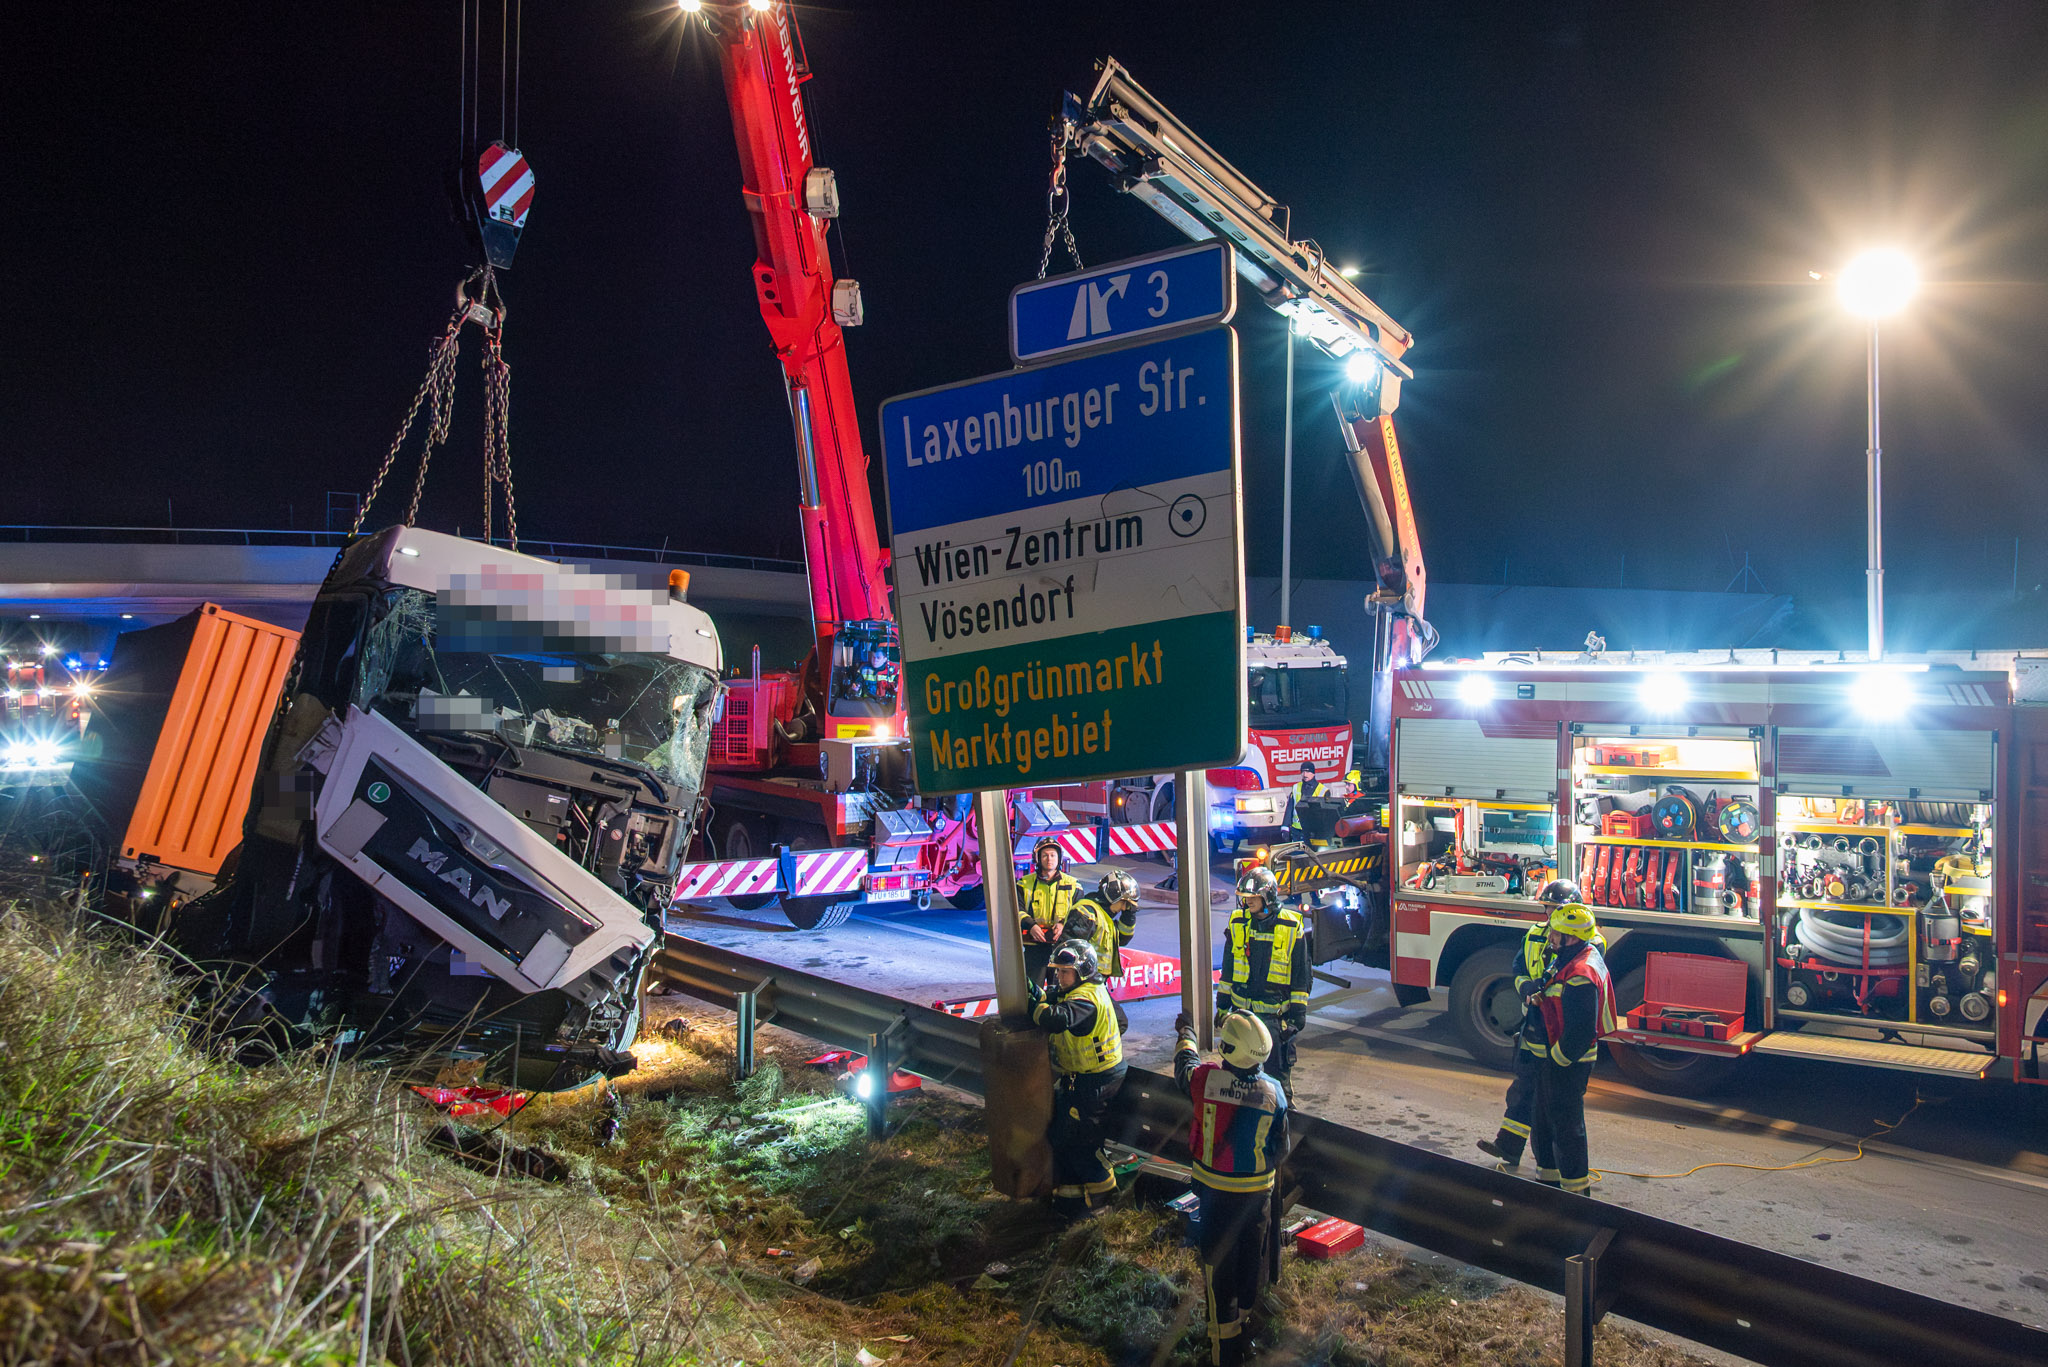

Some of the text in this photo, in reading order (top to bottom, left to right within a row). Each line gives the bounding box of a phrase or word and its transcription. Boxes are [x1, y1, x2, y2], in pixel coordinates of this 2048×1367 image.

[774, 0, 809, 162] UERWEHR
[1147, 270, 1169, 318] 3
[903, 357, 1206, 467] Laxenburger Str.
[1021, 457, 1081, 498] 100m
[915, 513, 1143, 587] Wien-Zentrum
[920, 575, 1075, 642] Vösendorf
[925, 638, 1164, 717] Großgrünmarkt
[929, 709, 1113, 774] Marktgebiet
[1271, 746, 1344, 763] FEUERWEHR
[1289, 733, 1328, 744] SCANIA
[406, 836, 511, 920] MAN
[1106, 962, 1174, 989] WEHR
